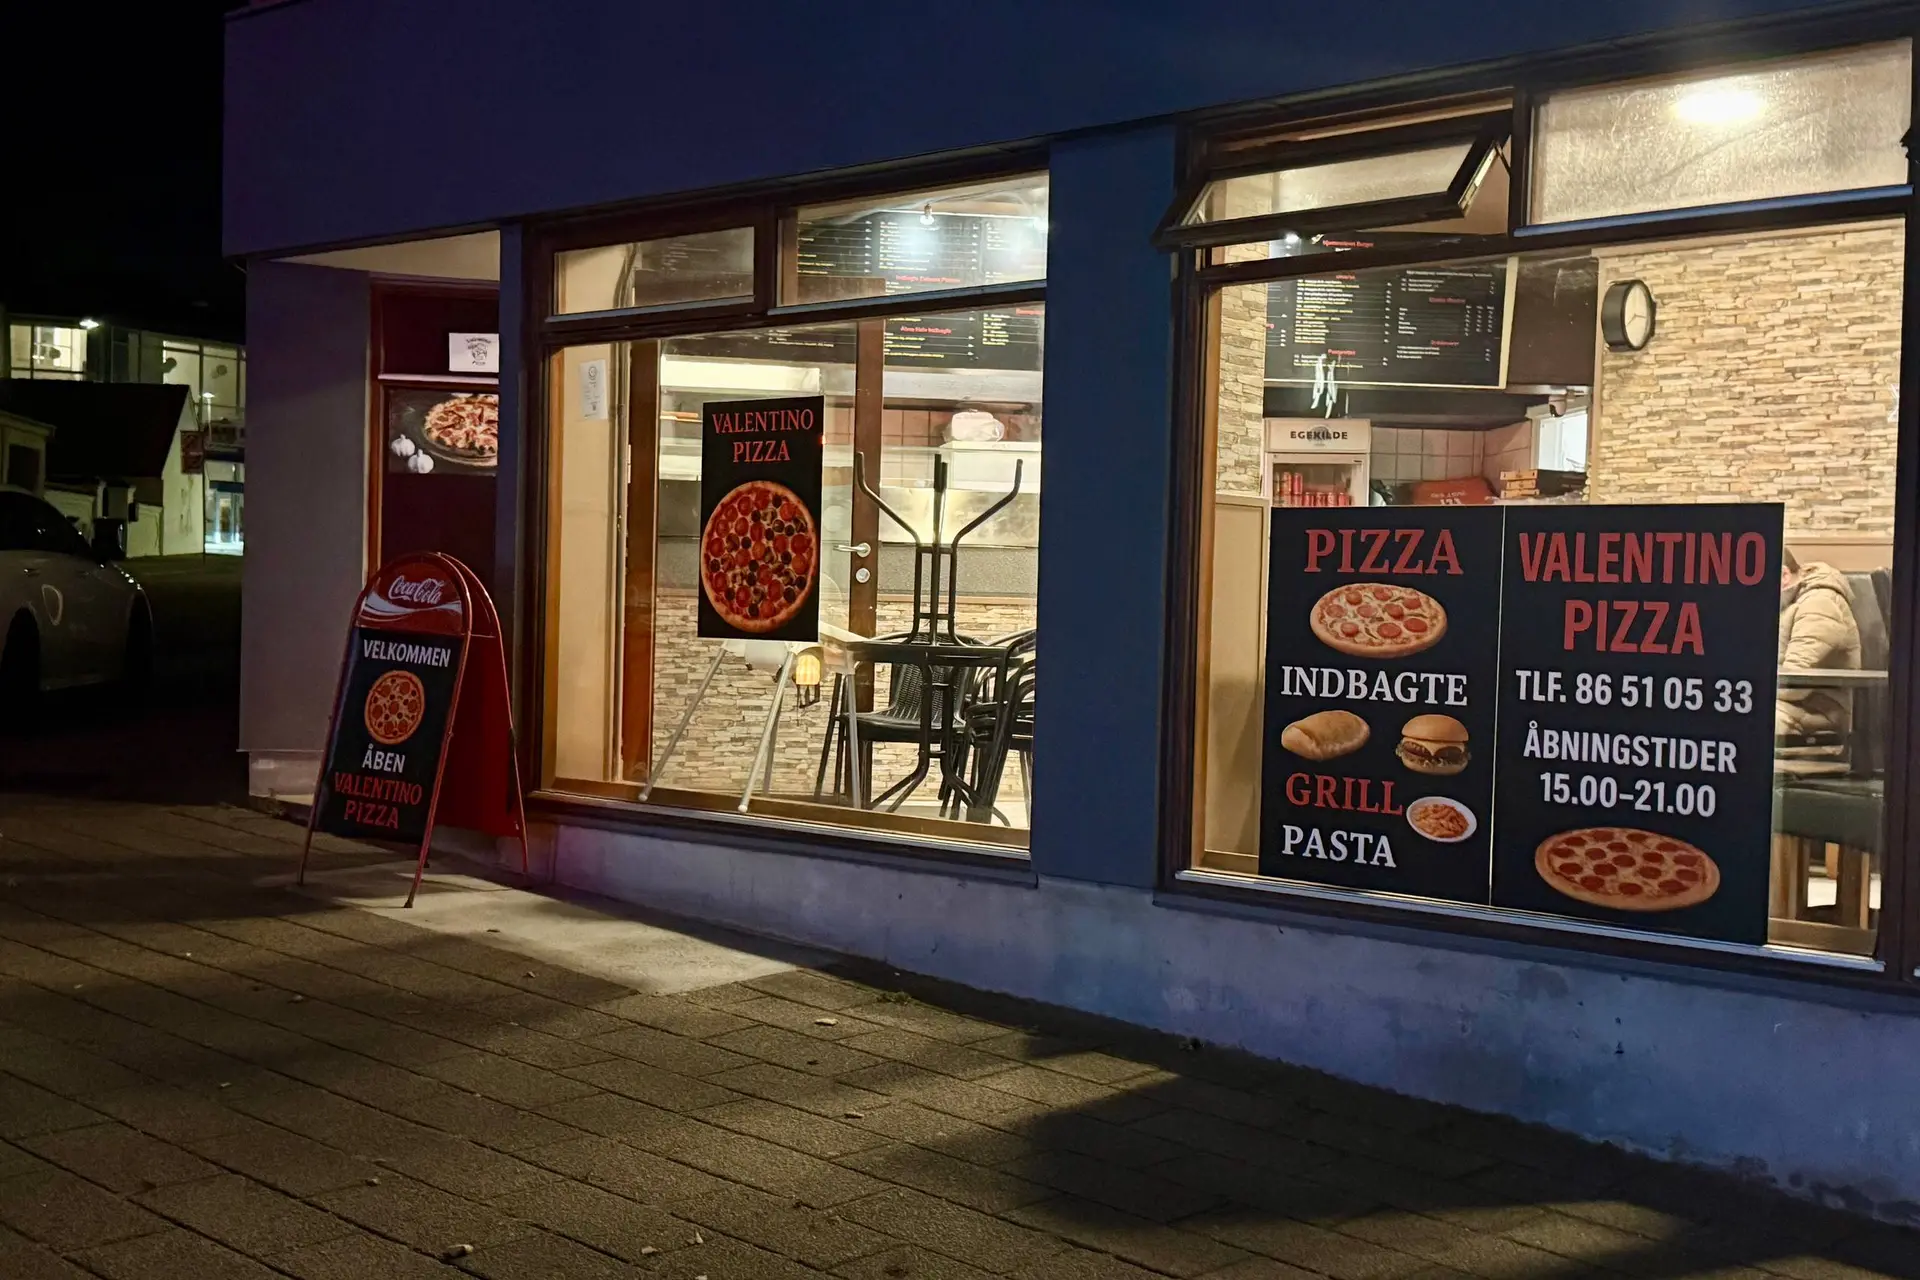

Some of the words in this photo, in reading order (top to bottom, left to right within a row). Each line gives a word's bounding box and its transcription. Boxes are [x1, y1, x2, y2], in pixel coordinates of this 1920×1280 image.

[712, 408, 814, 434] VALENTINO
[1290, 431, 1348, 440] EGEKILDE
[733, 440, 791, 463] PIZZA
[1304, 529, 1464, 575] PIZZA
[1519, 532, 1766, 586] VALENTINO
[1563, 599, 1705, 656] PIZZA
[363, 639, 451, 668] VELKOMMEN
[1281, 666, 1468, 706] INDBAGTE
[1516, 670, 1567, 703] TLF.
[1575, 673, 1612, 705] 86
[1621, 675, 1654, 708] 51
[1664, 677, 1703, 711] 05
[1714, 679, 1753, 714] 33
[362, 743, 406, 773] ÅBEN
[1523, 720, 1737, 773] ÅBNINGSTIDER
[335, 772, 423, 805] VALENTINO
[1285, 772, 1403, 815] GRILL
[1540, 772, 1716, 818] 15.00-21.00
[344, 800, 399, 830] PIZZA
[1282, 824, 1397, 868] PASTA
